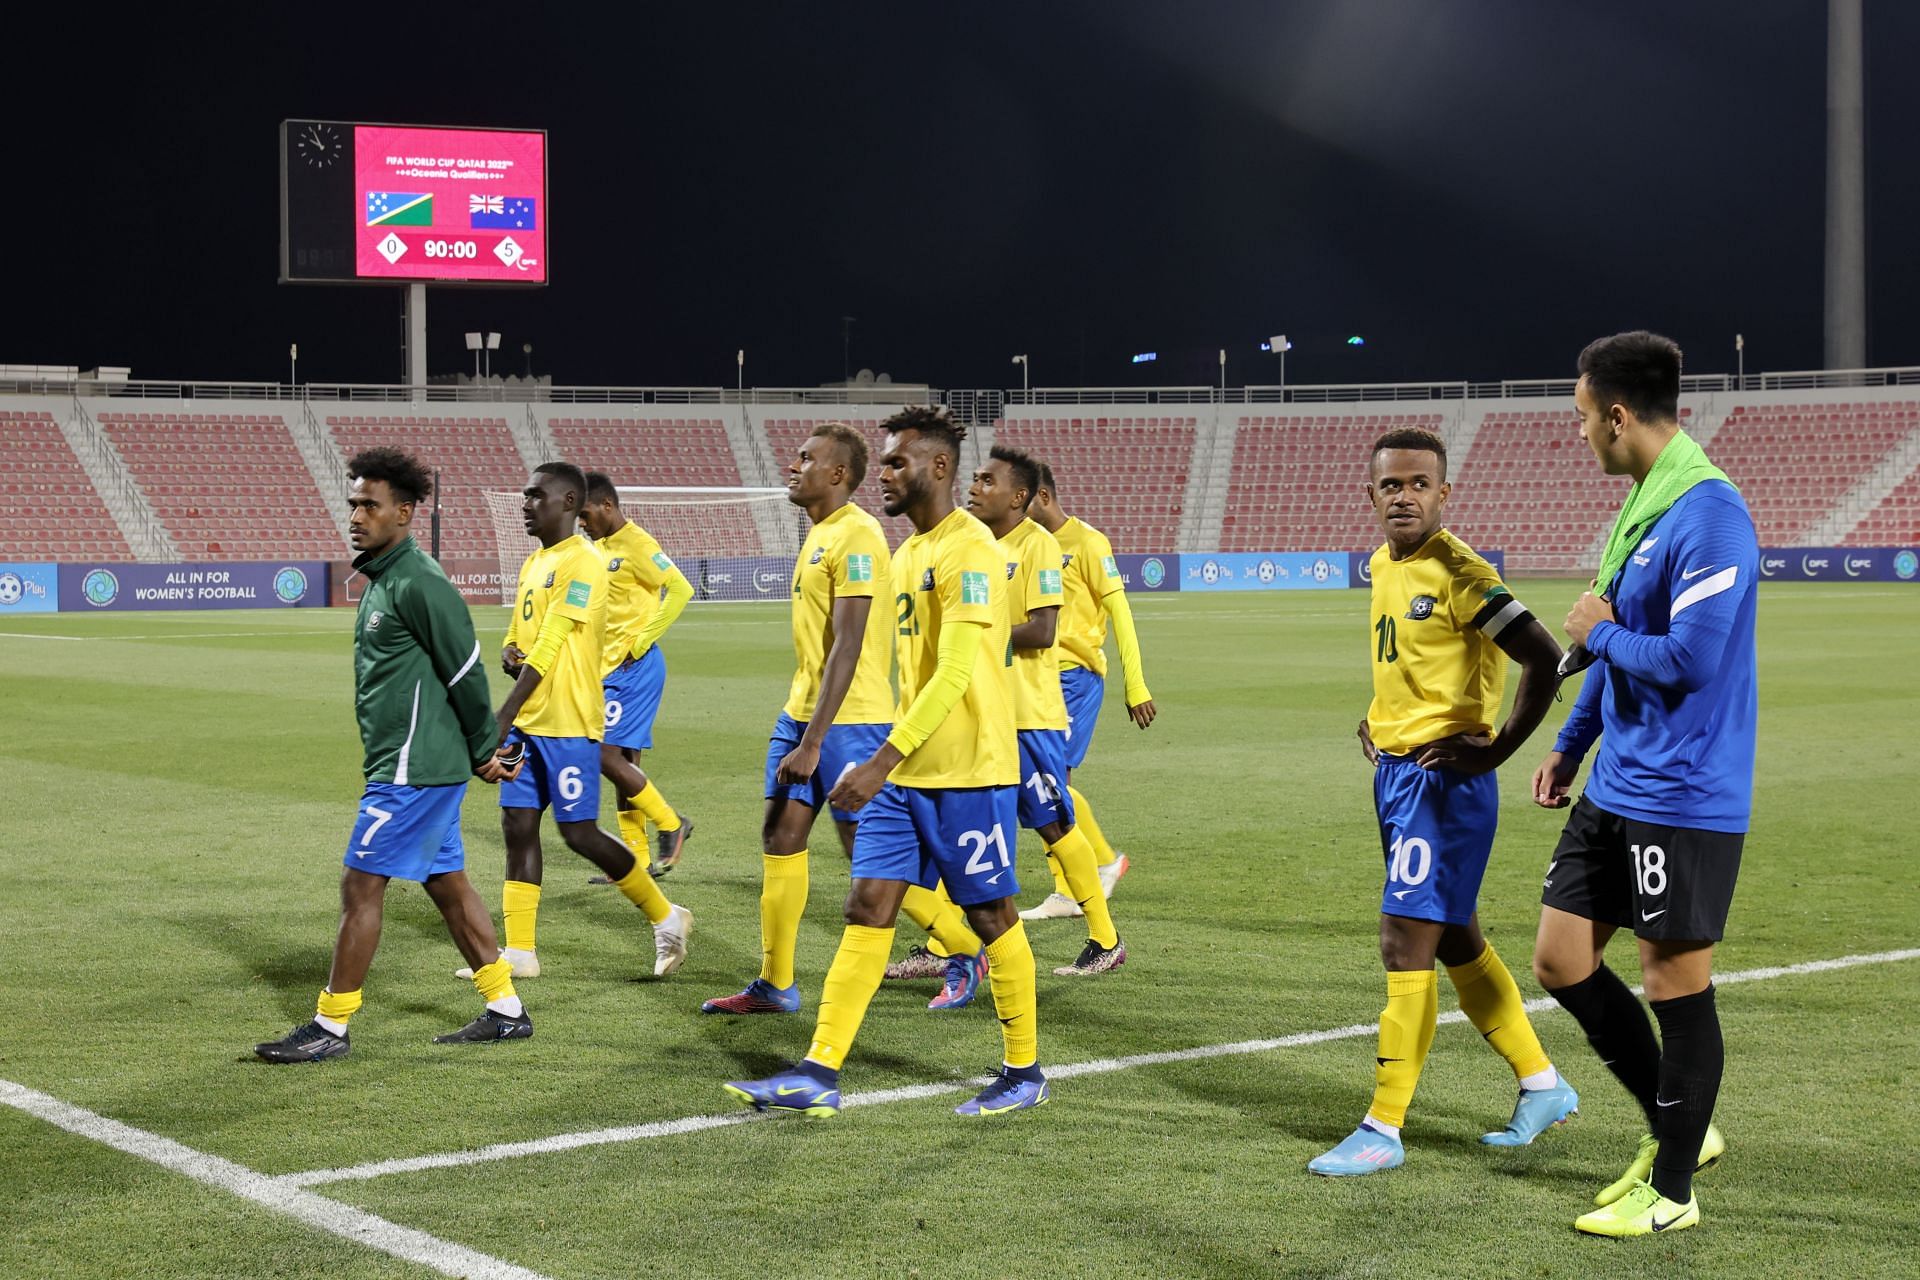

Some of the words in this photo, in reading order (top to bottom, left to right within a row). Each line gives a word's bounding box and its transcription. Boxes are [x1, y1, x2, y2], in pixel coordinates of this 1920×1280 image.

[386, 156, 404, 166] FIFA
[405, 157, 436, 167] WORLD
[437, 158, 455, 168] CUP
[456, 159, 486, 169] QATAR
[450, 169, 489, 180] Qualifiers
[387, 239, 397, 254] 0
[424, 240, 477, 258] 90:00
[504, 242, 514, 257] 5
[1766, 559, 1786, 568] OFC
[1808, 559, 1829, 568] OFC
[1851, 559, 1872, 568] OFC
[166, 572, 187, 585] ALL
[189, 572, 204, 584] IN
[206, 571, 230, 583] FOR
[450, 574, 466, 585] ALL
[468, 574, 487, 585] FOR
[489, 574, 518, 584] TONG
[708, 574, 732, 583] OFC
[761, 573, 785, 582] OFC
[23, 580, 46, 599] Play
[135, 587, 194, 600] WOMEN'S
[198, 585, 257, 599] FOOTBALL
[523, 589, 534, 621] 6
[1376, 614, 1399, 663] 10
[605, 700, 623, 727] 9
[557, 766, 584, 800] 6
[360, 806, 392, 847] 7
[957, 823, 1011, 875] 21
[1389, 835, 1431, 886] 10
[1630, 844, 1667, 896] 18
